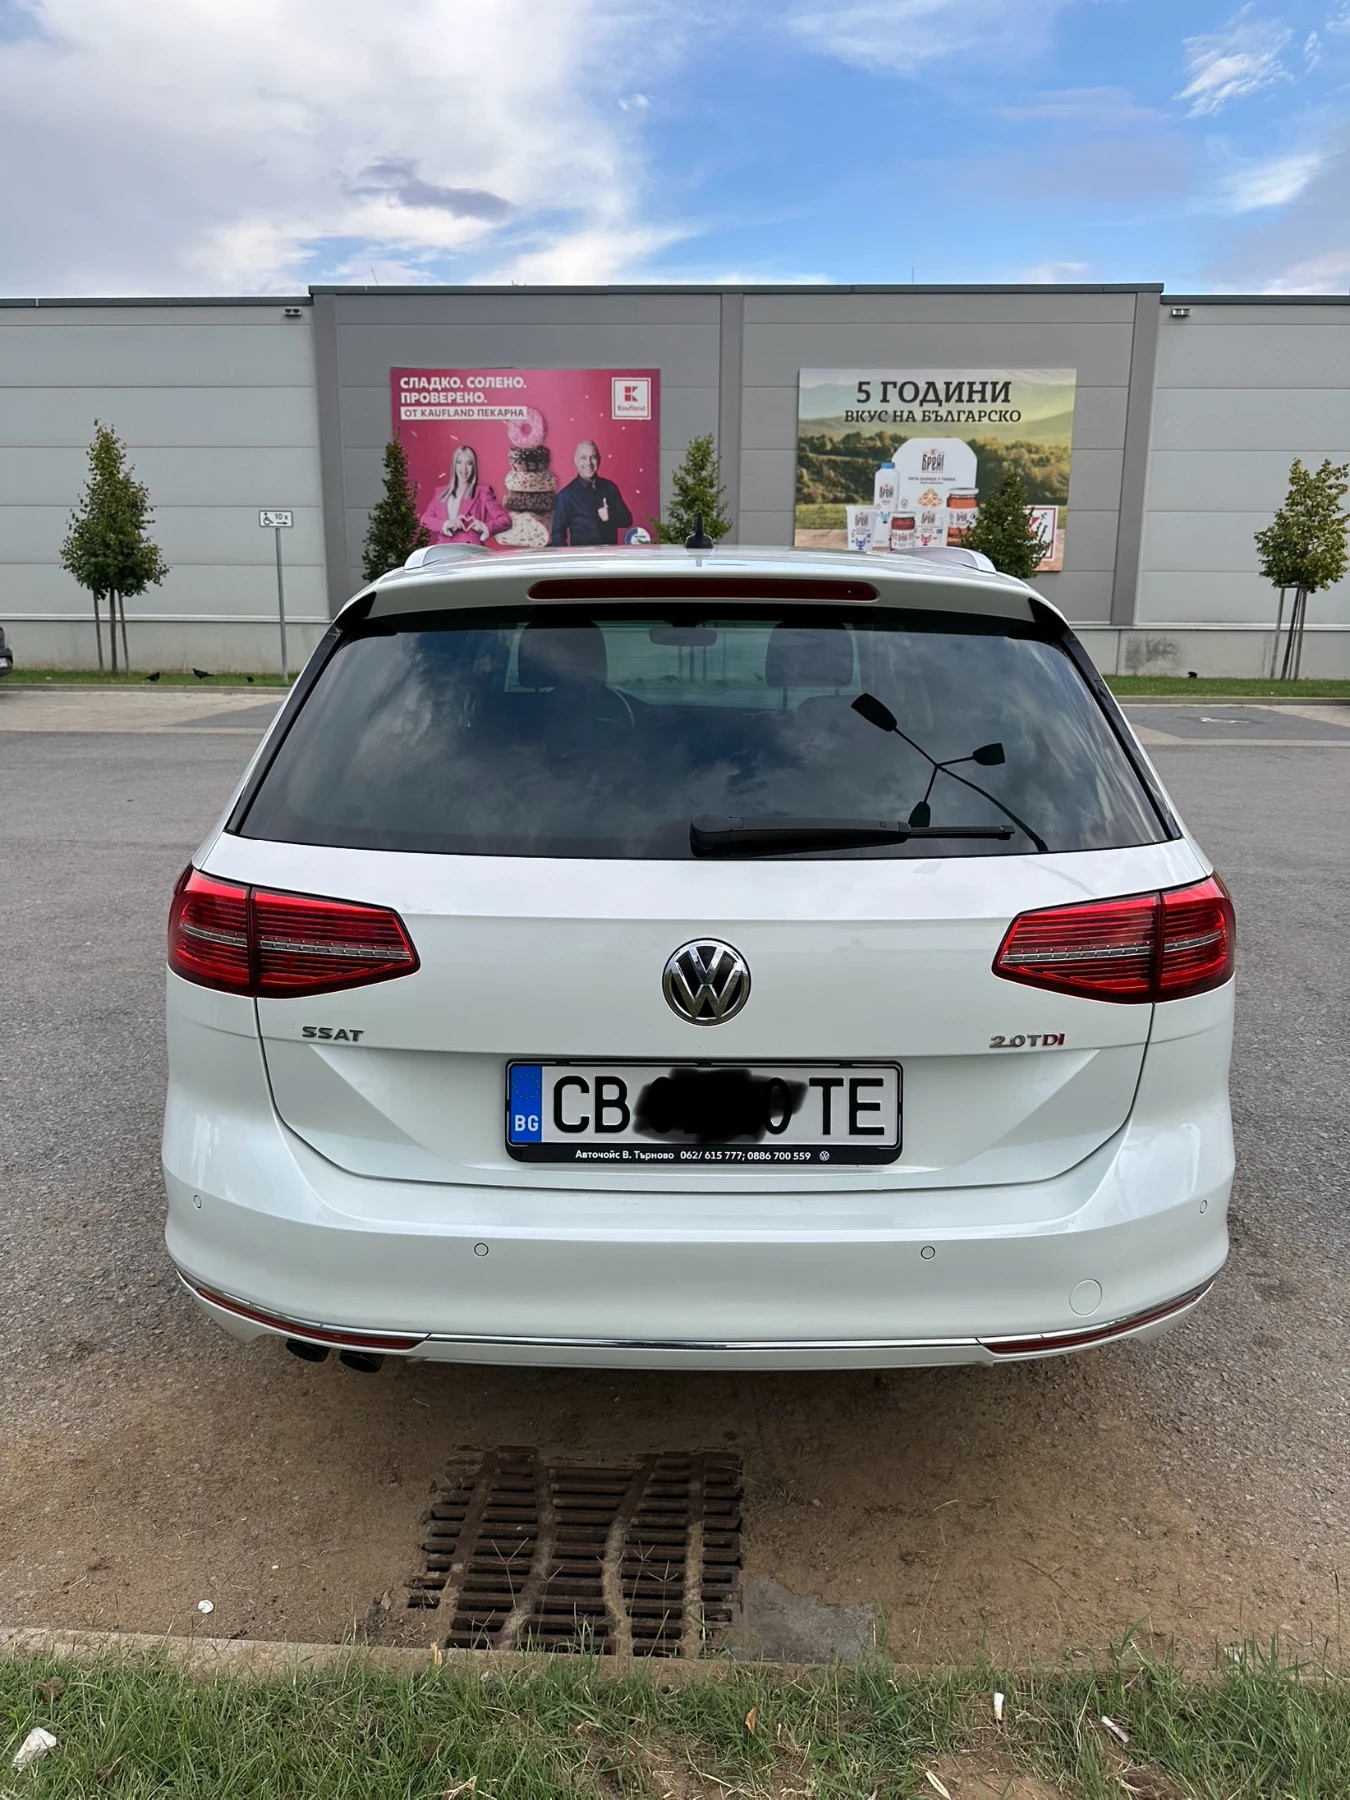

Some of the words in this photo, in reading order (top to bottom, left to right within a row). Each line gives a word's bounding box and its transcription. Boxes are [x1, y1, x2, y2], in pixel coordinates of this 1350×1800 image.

[400, 377, 464, 390] СЛАДКО.
[466, 377, 527, 388] СОЛЕНО.
[400, 392, 488, 403] ПРОВЕРЕНО.
[856, 381, 871, 403] 5
[880, 381, 1012, 407] ГОДИНИ
[404, 409, 418, 418] ОТ
[420, 409, 475, 418] KAUFLAND
[477, 409, 525, 418] ПЕКАРНА
[844, 410, 888, 423] ВКУС
[892, 410, 917, 423] НА
[921, 410, 1022, 423] БЪЛГАРСКО
[302, 1026, 364, 1042] SSAT
[553, 1075, 631, 1133] CB
[808, 1077, 885, 1136] TE
[514, 1114, 539, 1132] BG
[575, 1149, 621, 1159] Авточойс
[622, 1150, 632, 1159] В.
[634, 1150, 675, 1161] Търново
[680, 1151, 702, 1160] 062/
[704, 1151, 722, 1160] 615
[724, 1151, 746, 1161] 777;
[747, 1151, 771, 1160] 0886
[773, 1151, 792, 1160] 700
[793, 1151, 811, 1160] 559
